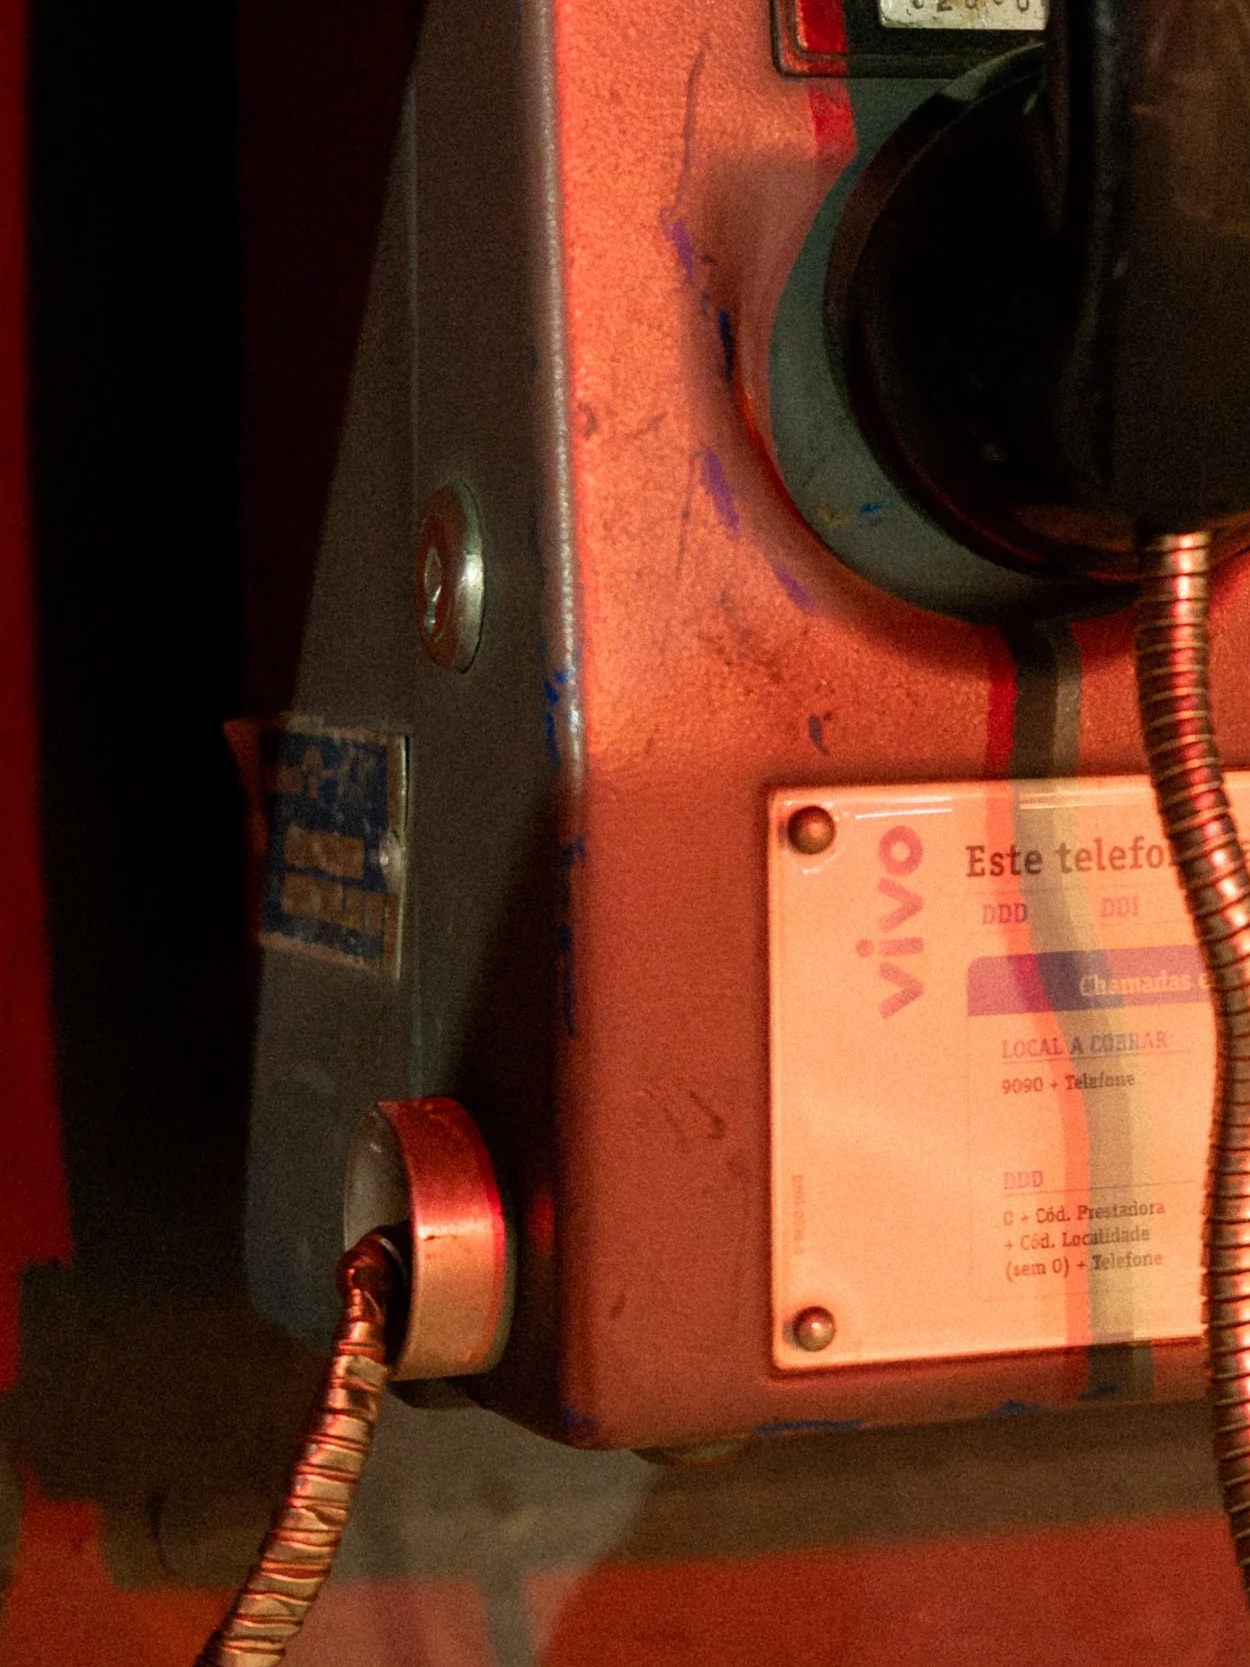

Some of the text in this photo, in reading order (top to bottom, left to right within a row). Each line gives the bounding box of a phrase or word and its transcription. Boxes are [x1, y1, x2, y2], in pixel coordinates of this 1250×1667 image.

[965, 844, 1043, 878] Este
[1056, 835, 1176, 873] telefo
[855, 825, 925, 1020] vivo
[1079, 970, 1193, 996] Chamadas
[1001, 1036, 1063, 1058] LOCAL
[1070, 1037, 1084, 1055] A
[1001, 1071, 1136, 1094] 9090 Telefone
[1036, 1201, 1166, 1223] Cód. Prestadora
[1020, 1227, 1151, 1251] Cód. Localidade
[1005, 1252, 1164, 1281] (sem 0) Telefone
